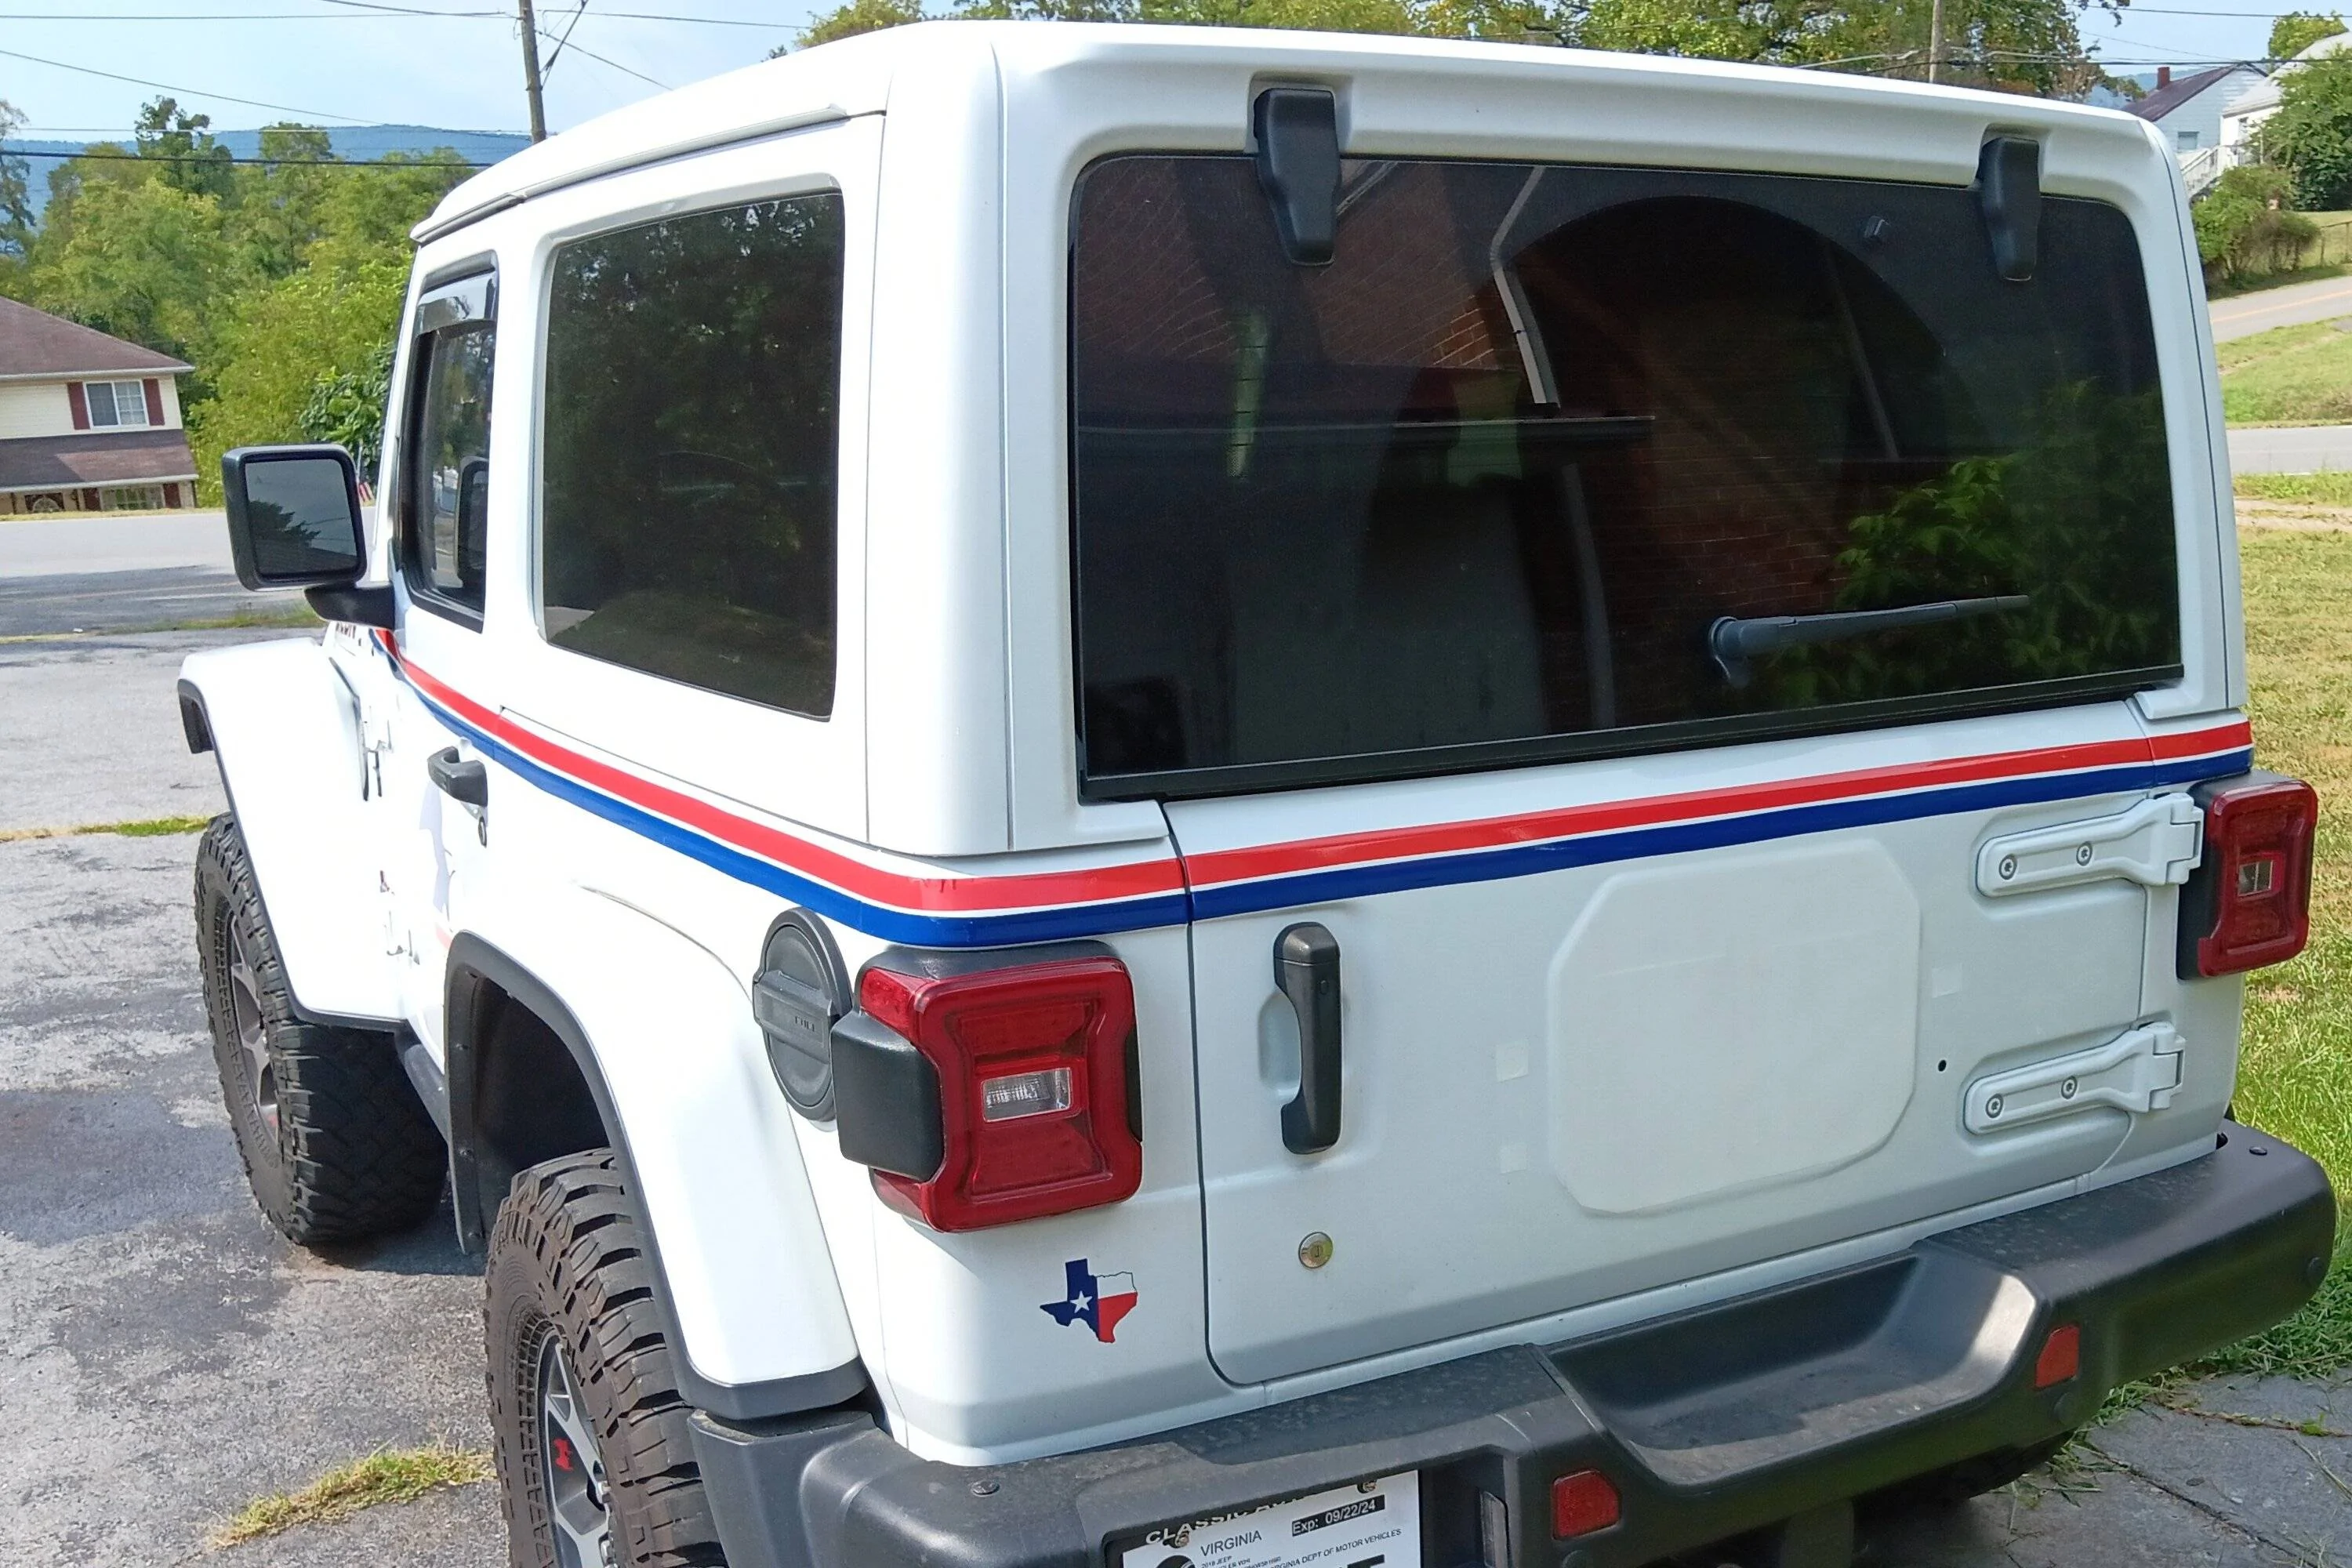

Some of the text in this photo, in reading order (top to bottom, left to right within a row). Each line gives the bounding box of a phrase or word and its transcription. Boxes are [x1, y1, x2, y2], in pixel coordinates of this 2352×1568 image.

[1293, 1499, 1376, 1534] Exp: 09/22/24
[1200, 1530, 1262, 1557] VIRGINIA
[1301, 1550, 1322, 1564] DEPT
[1335, 1539, 1363, 1554] MOTOR
[1364, 1528, 1402, 1545] VEHICLES
